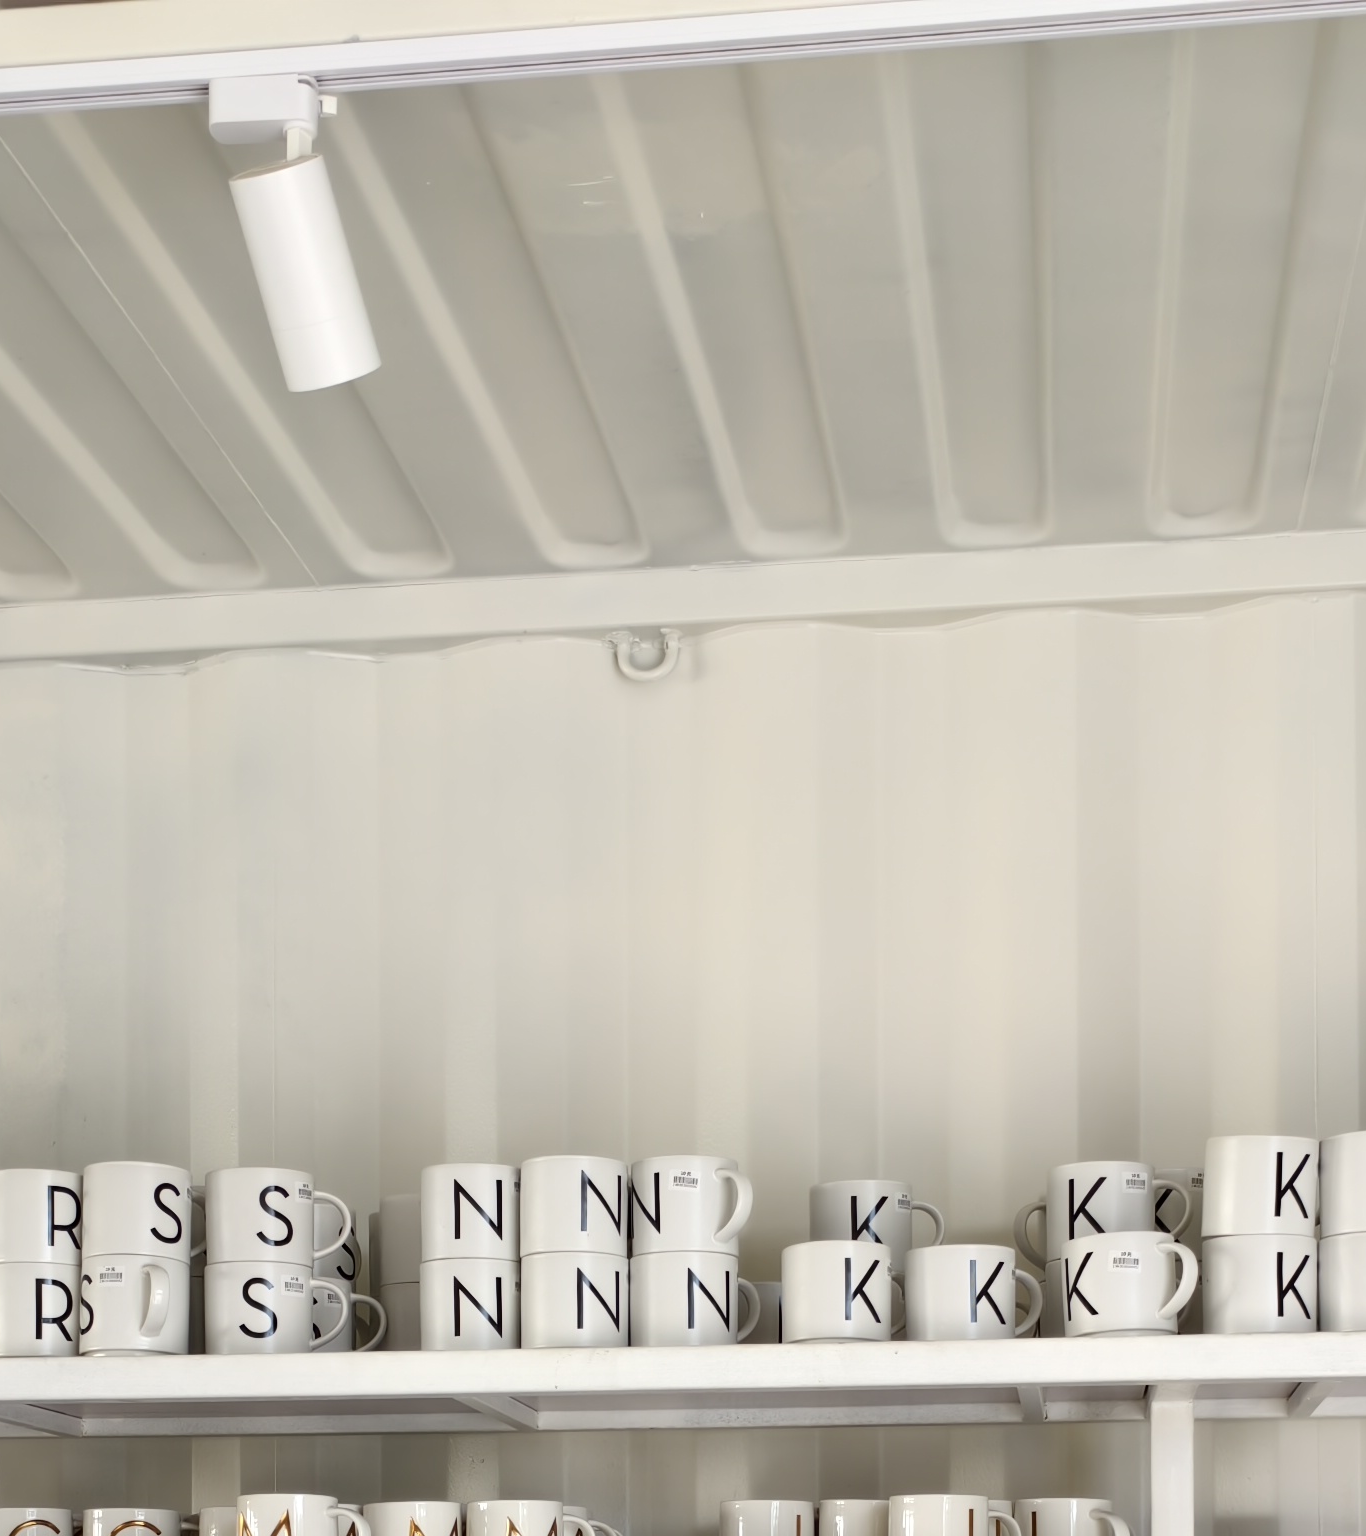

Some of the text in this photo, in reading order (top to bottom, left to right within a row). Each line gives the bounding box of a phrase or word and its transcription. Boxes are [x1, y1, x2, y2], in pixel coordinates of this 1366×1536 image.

[150, 1183, 182, 1243] S
[257, 1185, 293, 1246] S
[455, 1179, 502, 1239] N
[581, 1170, 621, 1237] N
[1069, 1177, 1106, 1240] K
[1274, 1152, 1310, 1218] K
[36, 1278, 72, 1341] R
[239, 1278, 277, 1338] S
[577, 1268, 620, 1332] N
[688, 1267, 730, 1331] N
[845, 1258, 880, 1323] K
[970, 1260, 1006, 1325] K
[1065, 1252, 1099, 1321] K
[1278, 1252, 1310, 1318] K
